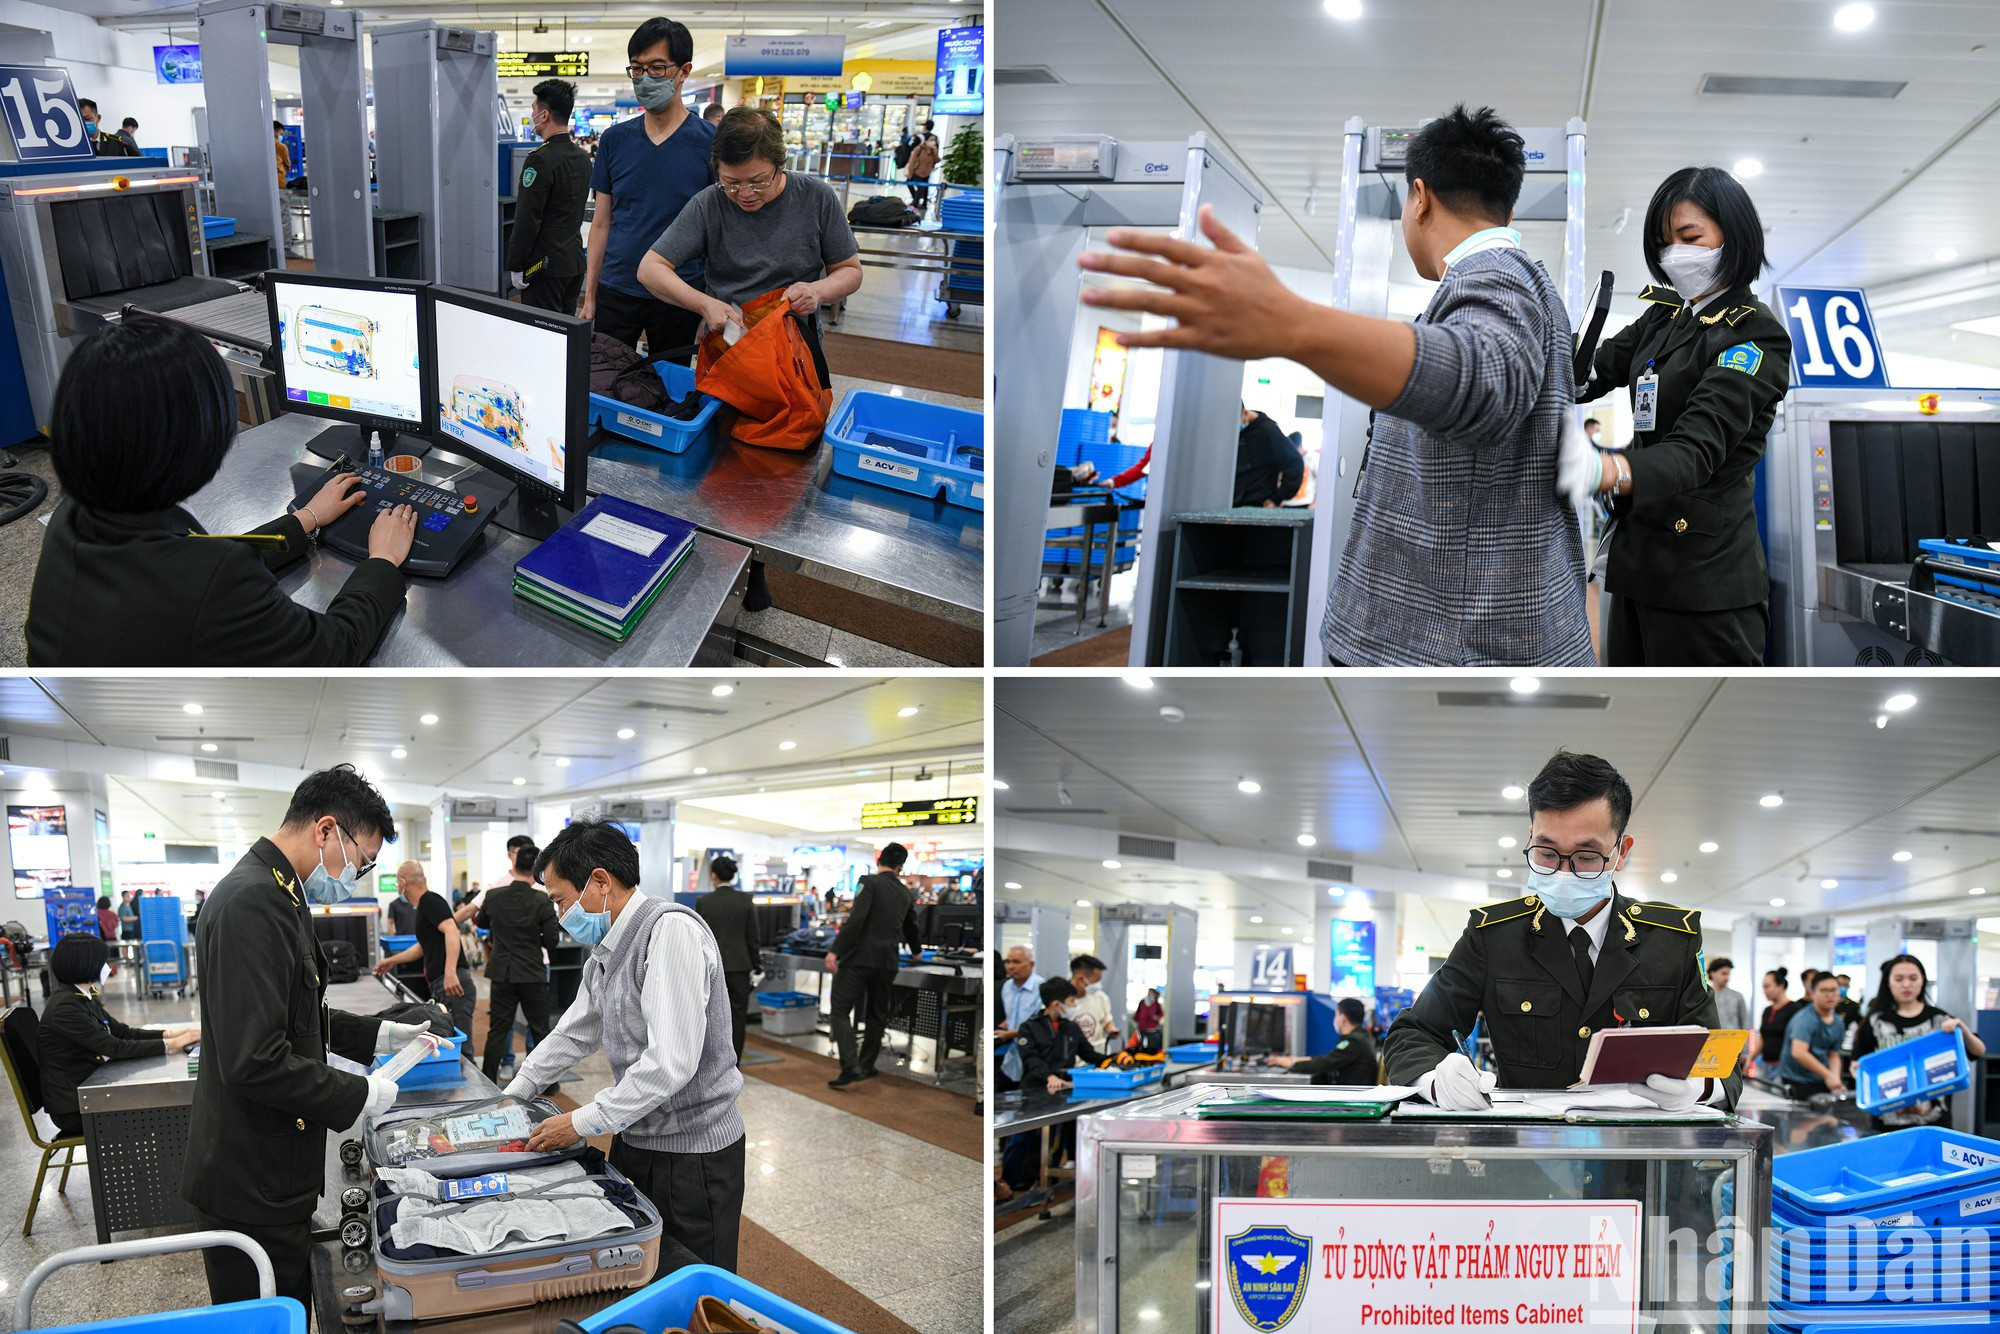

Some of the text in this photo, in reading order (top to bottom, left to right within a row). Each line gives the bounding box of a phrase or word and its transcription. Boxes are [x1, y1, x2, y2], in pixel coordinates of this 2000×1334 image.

[761, 48, 811, 56] 0912.525.070
[1, 77, 82, 148] 15
[1788, 296, 1875, 379] 16
[441, 419, 465, 438] HiTraX
[874, 460, 895, 471] ACV
[1253, 949, 1288, 986] 14
[1962, 1152, 1985, 1167] ACV
[1974, 1198, 1993, 1209] ACV
[1322, 1219, 1622, 1289] TỦ ĐỰNG VẬT PHẨM NGUY HIỂM
[1243, 1282, 1252, 1292] AN
[1252, 1282, 1269, 1292] NINH
[1282, 1282, 1295, 1292] BAY
[1361, 1303, 1584, 1325] Prohibited Items Cabinet
